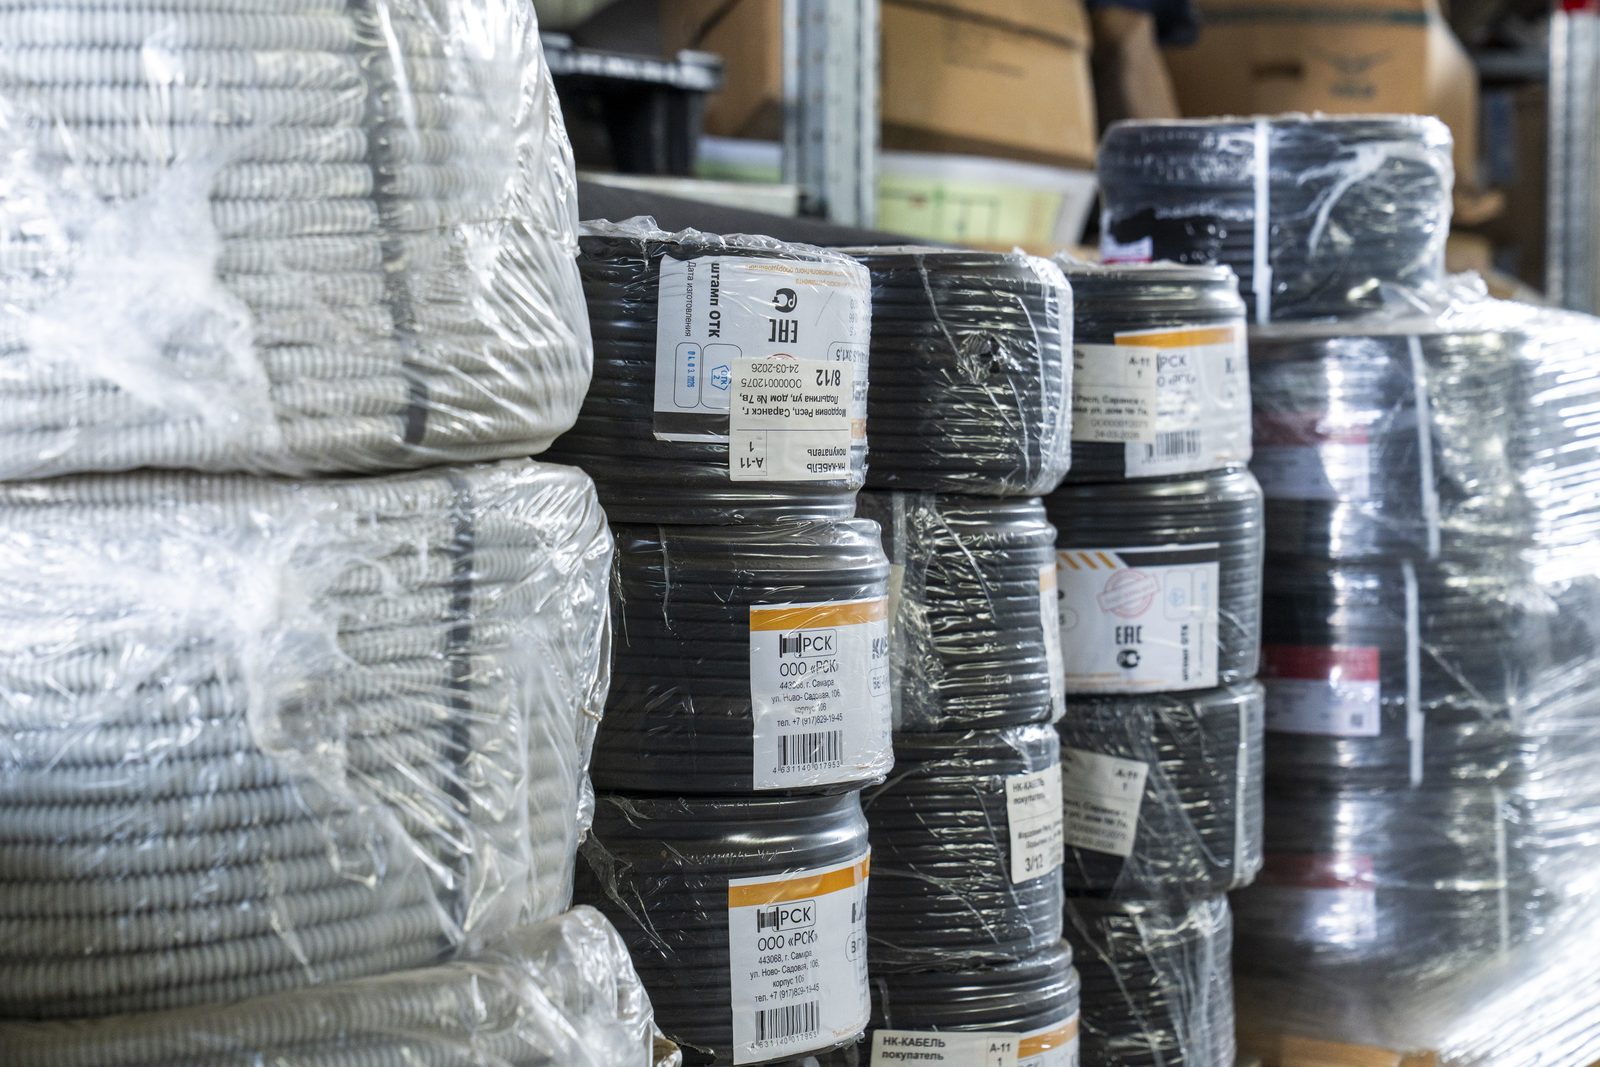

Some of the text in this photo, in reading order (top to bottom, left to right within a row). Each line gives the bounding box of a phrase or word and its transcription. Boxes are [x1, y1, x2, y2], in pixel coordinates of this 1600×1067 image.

[684, 261, 696, 337] Дата изготовления
[709, 263, 721, 338] штамп ОТК
[752, 363, 799, 373] 24-03-2026
[816, 369, 840, 386] 8/12
[740, 393, 838, 404] Лодыгина ул, дом № 7в,
[742, 406, 749, 415] г,
[752, 406, 790, 417] Саранск
[792, 406, 813, 417] Респ,
[749, 441, 754, 452] 1
[807, 447, 846, 457] покупатель
[740, 457, 763, 468] А-11
[803, 636, 831, 652] РСК
[780, 662, 807, 676] ООО
[771, 696, 781, 704] ул.
[793, 717, 800, 725] +7
[780, 906, 811, 926] РСК
[757, 935, 785, 952] ООО
[758, 954, 783, 964] 443068,
[750, 971, 760, 980] ул.
[773, 978, 793, 988] корпус
[883, 1036, 946, 1048] НК-КАБЕЛЬ
[990, 1044, 1011, 1053] А-11
[882, 1051, 944, 1061] покупатель
